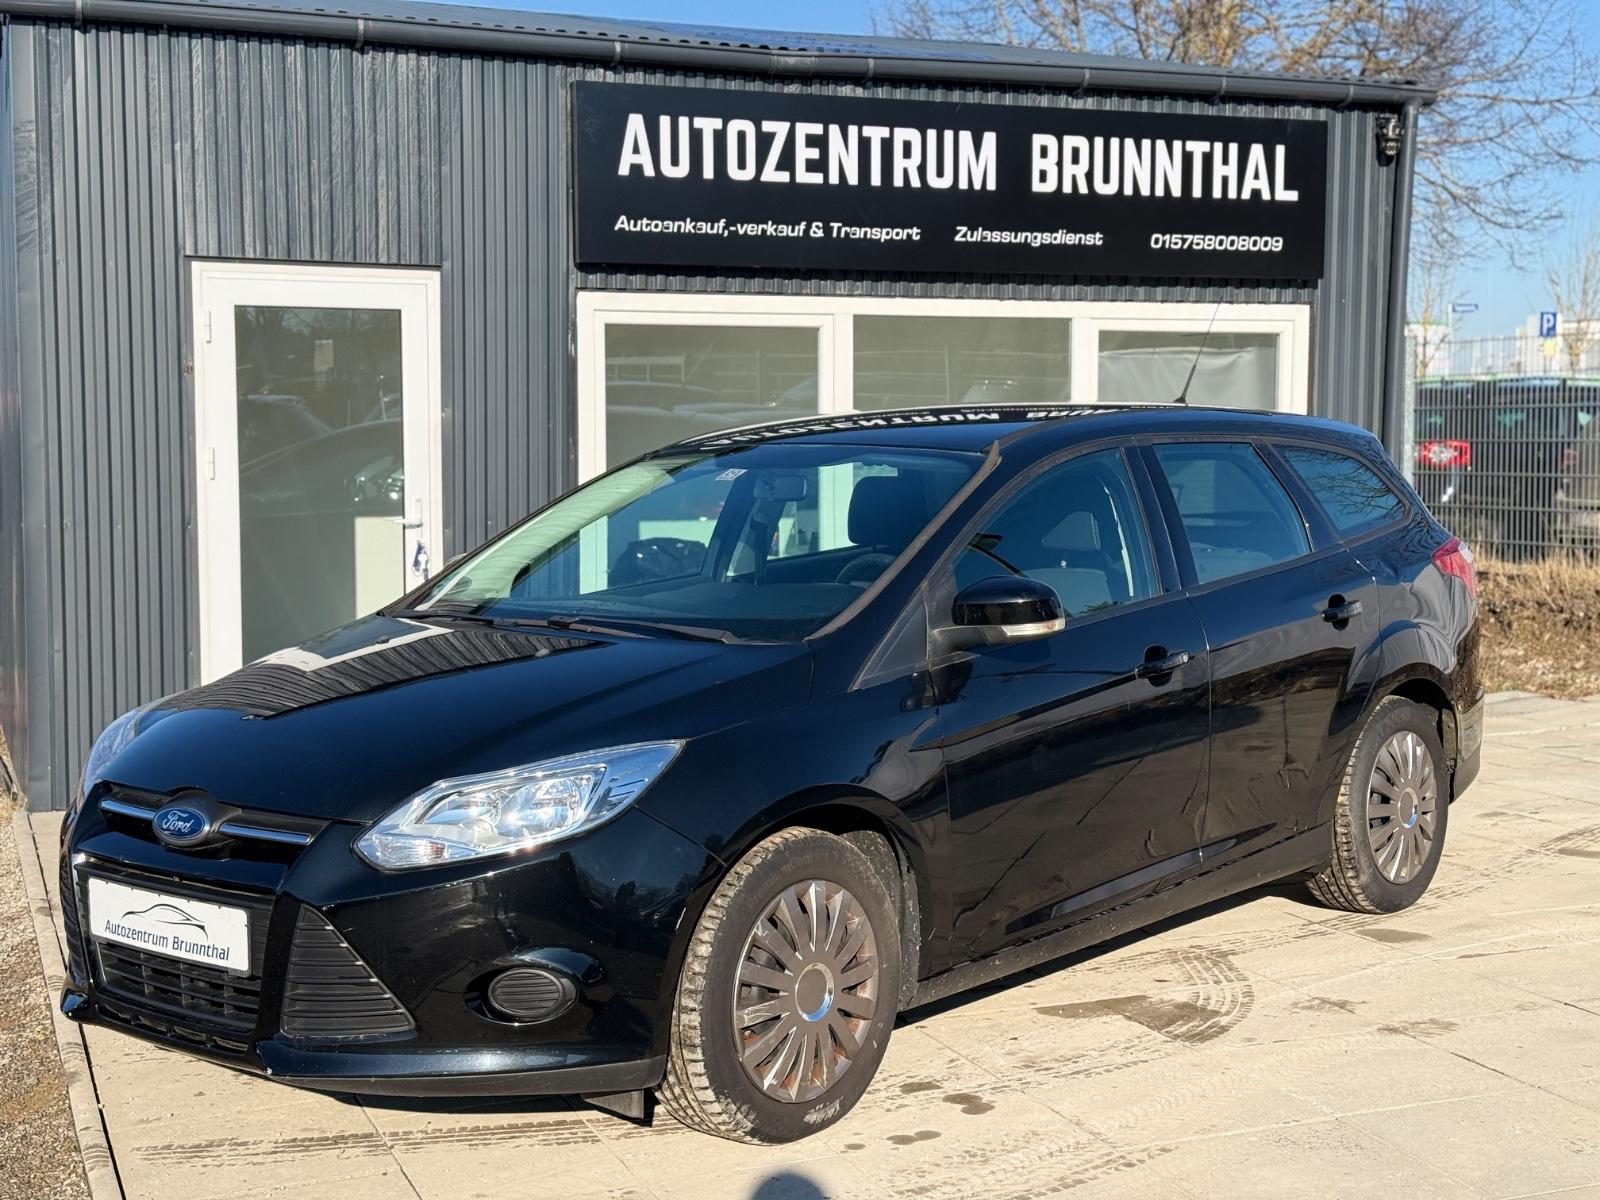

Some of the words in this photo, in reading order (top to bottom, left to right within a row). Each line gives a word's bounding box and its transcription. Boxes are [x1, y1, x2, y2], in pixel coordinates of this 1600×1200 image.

[617, 112, 997, 191] AUTOZENTRUM
[1031, 133, 1299, 202] BRUNNTHAL
[809, 222, 825, 238] &
[829, 222, 922, 243] Transport
[953, 225, 1104, 248] Zulassungsdienst
[1150, 233, 1284, 252] 015758008009
[1542, 313, 1555, 336] P
[162, 810, 194, 833] Ford
[105, 919, 168, 949] Autozentrum
[171, 935, 230, 961] Brunnthal
